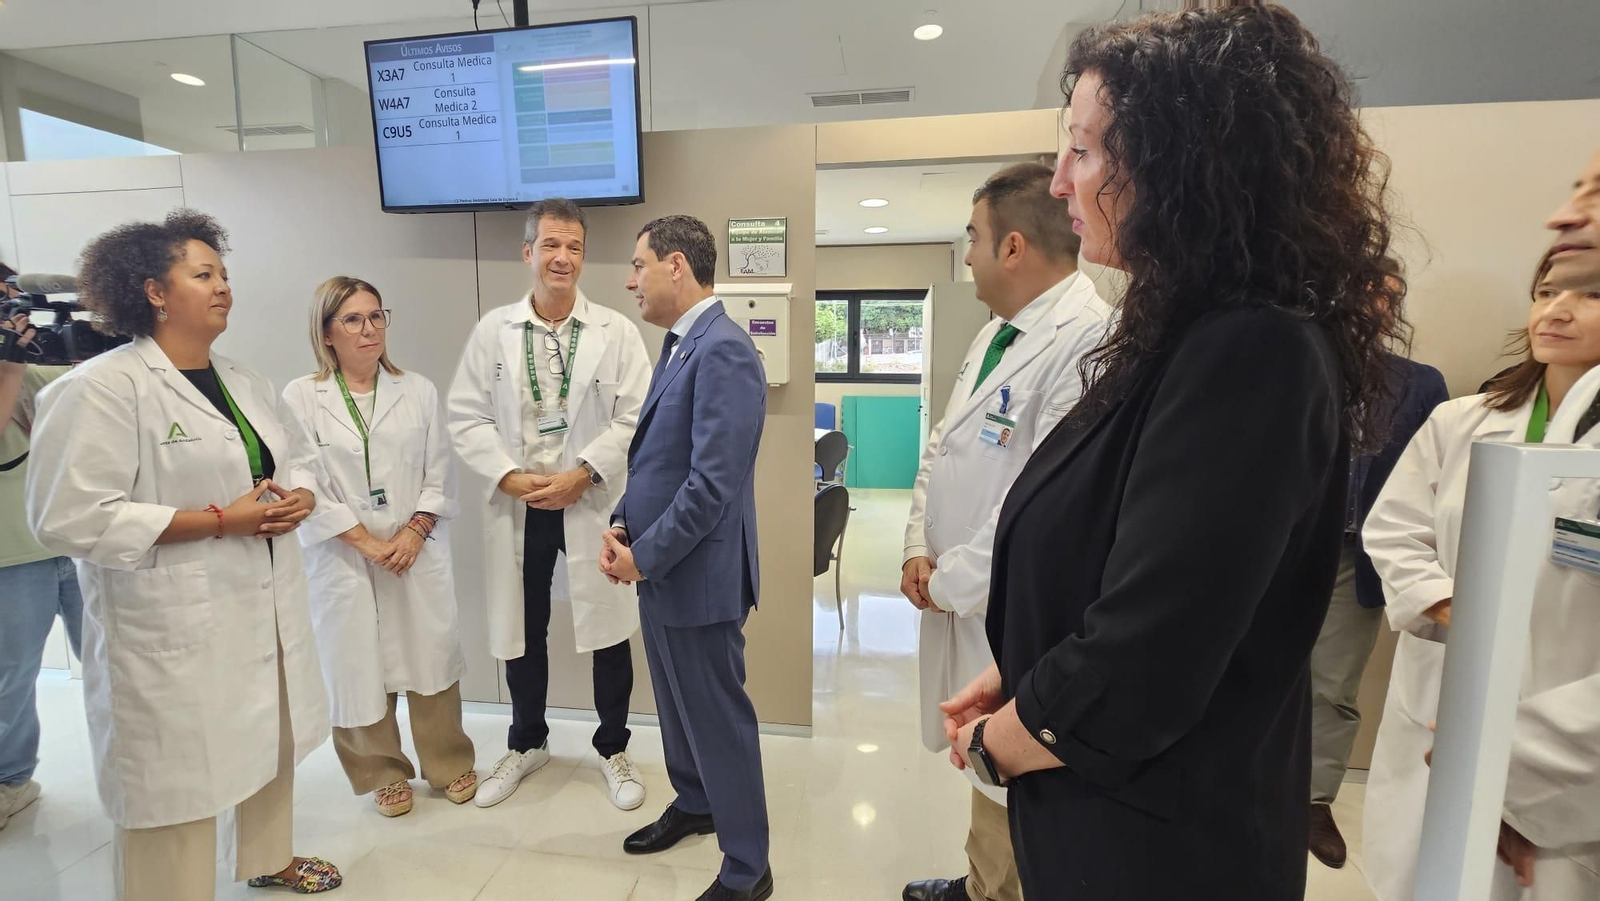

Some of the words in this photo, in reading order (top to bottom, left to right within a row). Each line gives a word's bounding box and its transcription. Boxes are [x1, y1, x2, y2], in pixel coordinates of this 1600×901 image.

[413, 58, 455, 72] Consulta
[457, 55, 492, 68] Medica
[377, 68, 405, 82] X3A7
[451, 73, 456, 82] 1
[434, 86, 476, 99] Consulta
[378, 97, 410, 111] W4A7
[435, 101, 469, 113] Medica
[471, 100, 477, 110] 2
[419, 116, 460, 129] Consulta
[462, 114, 497, 126] Medica
[383, 125, 413, 139] C9U5
[456, 131, 461, 140] 1
[731, 220, 766, 228] Consulta
